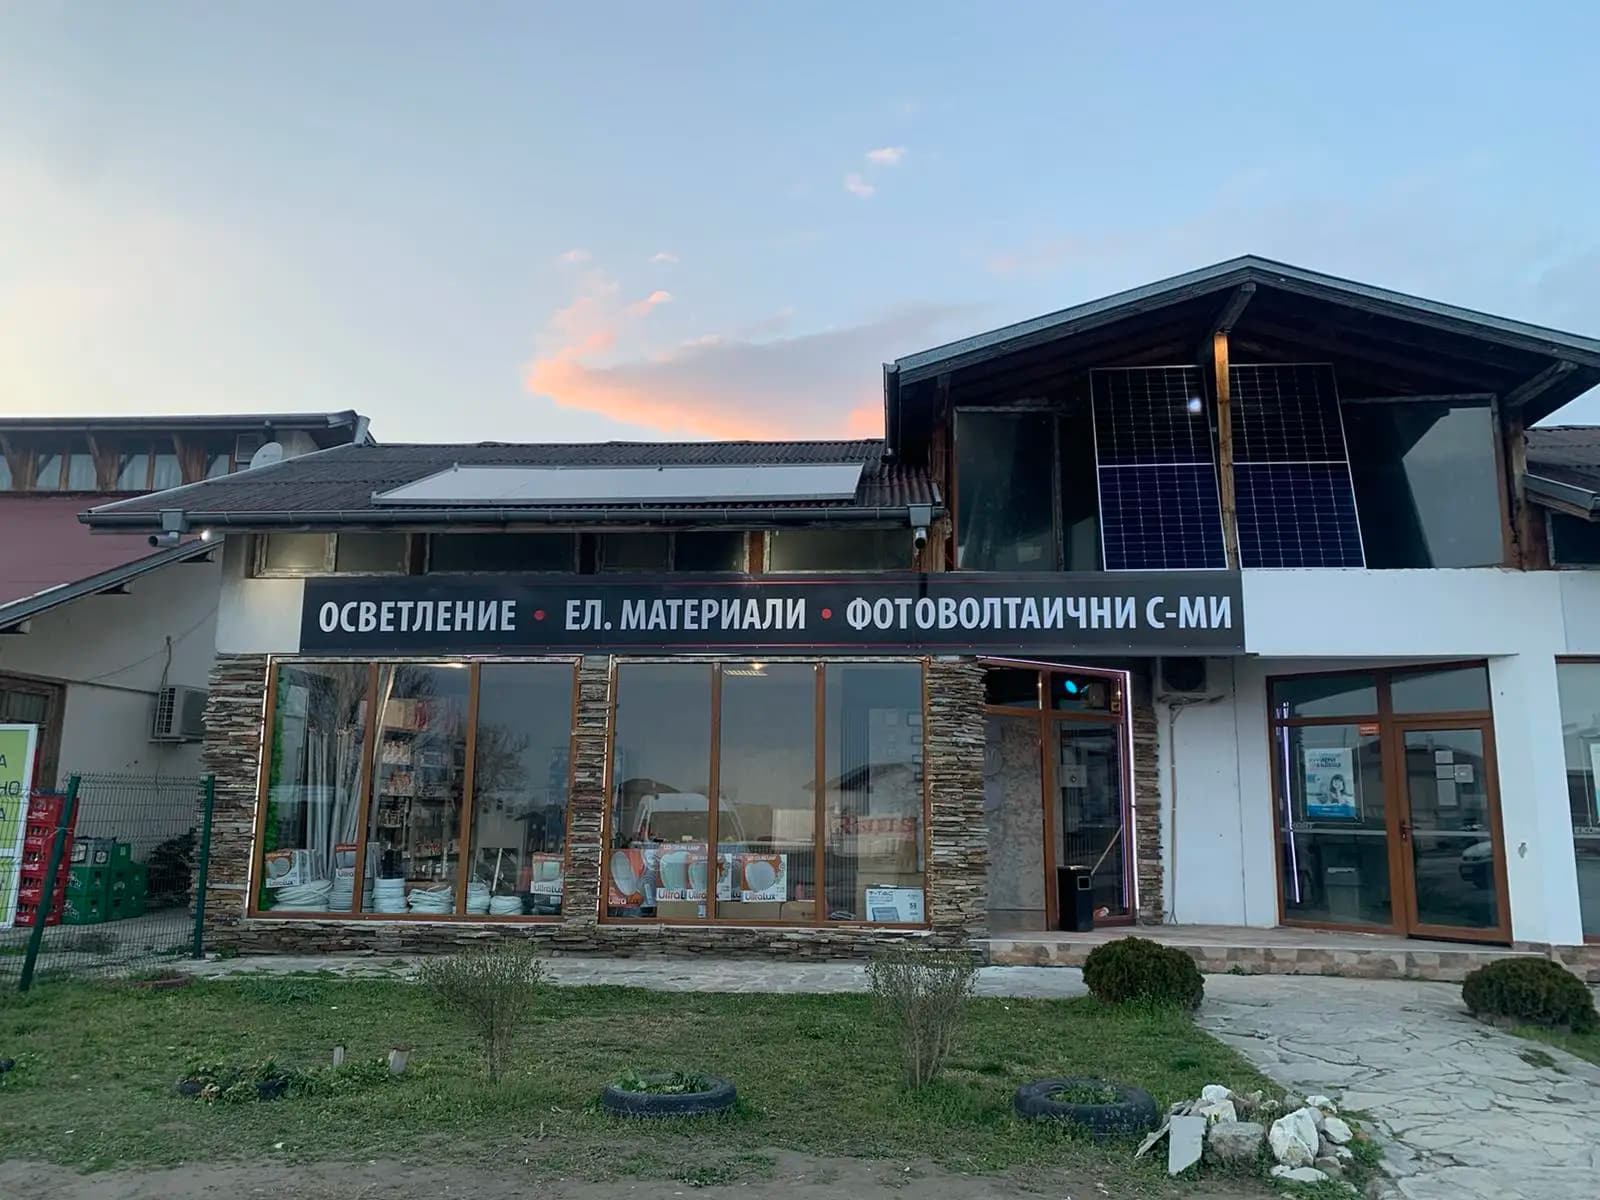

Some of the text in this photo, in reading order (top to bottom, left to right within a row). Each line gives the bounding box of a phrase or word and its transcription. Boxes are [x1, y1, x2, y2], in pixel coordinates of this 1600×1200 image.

[319, 596, 1232, 633] ОСВЕТЛЕНИЕ ЕЛ. МАТЕРИАЛИ ФОТОВОЛТАИЧНИ С-МИ
